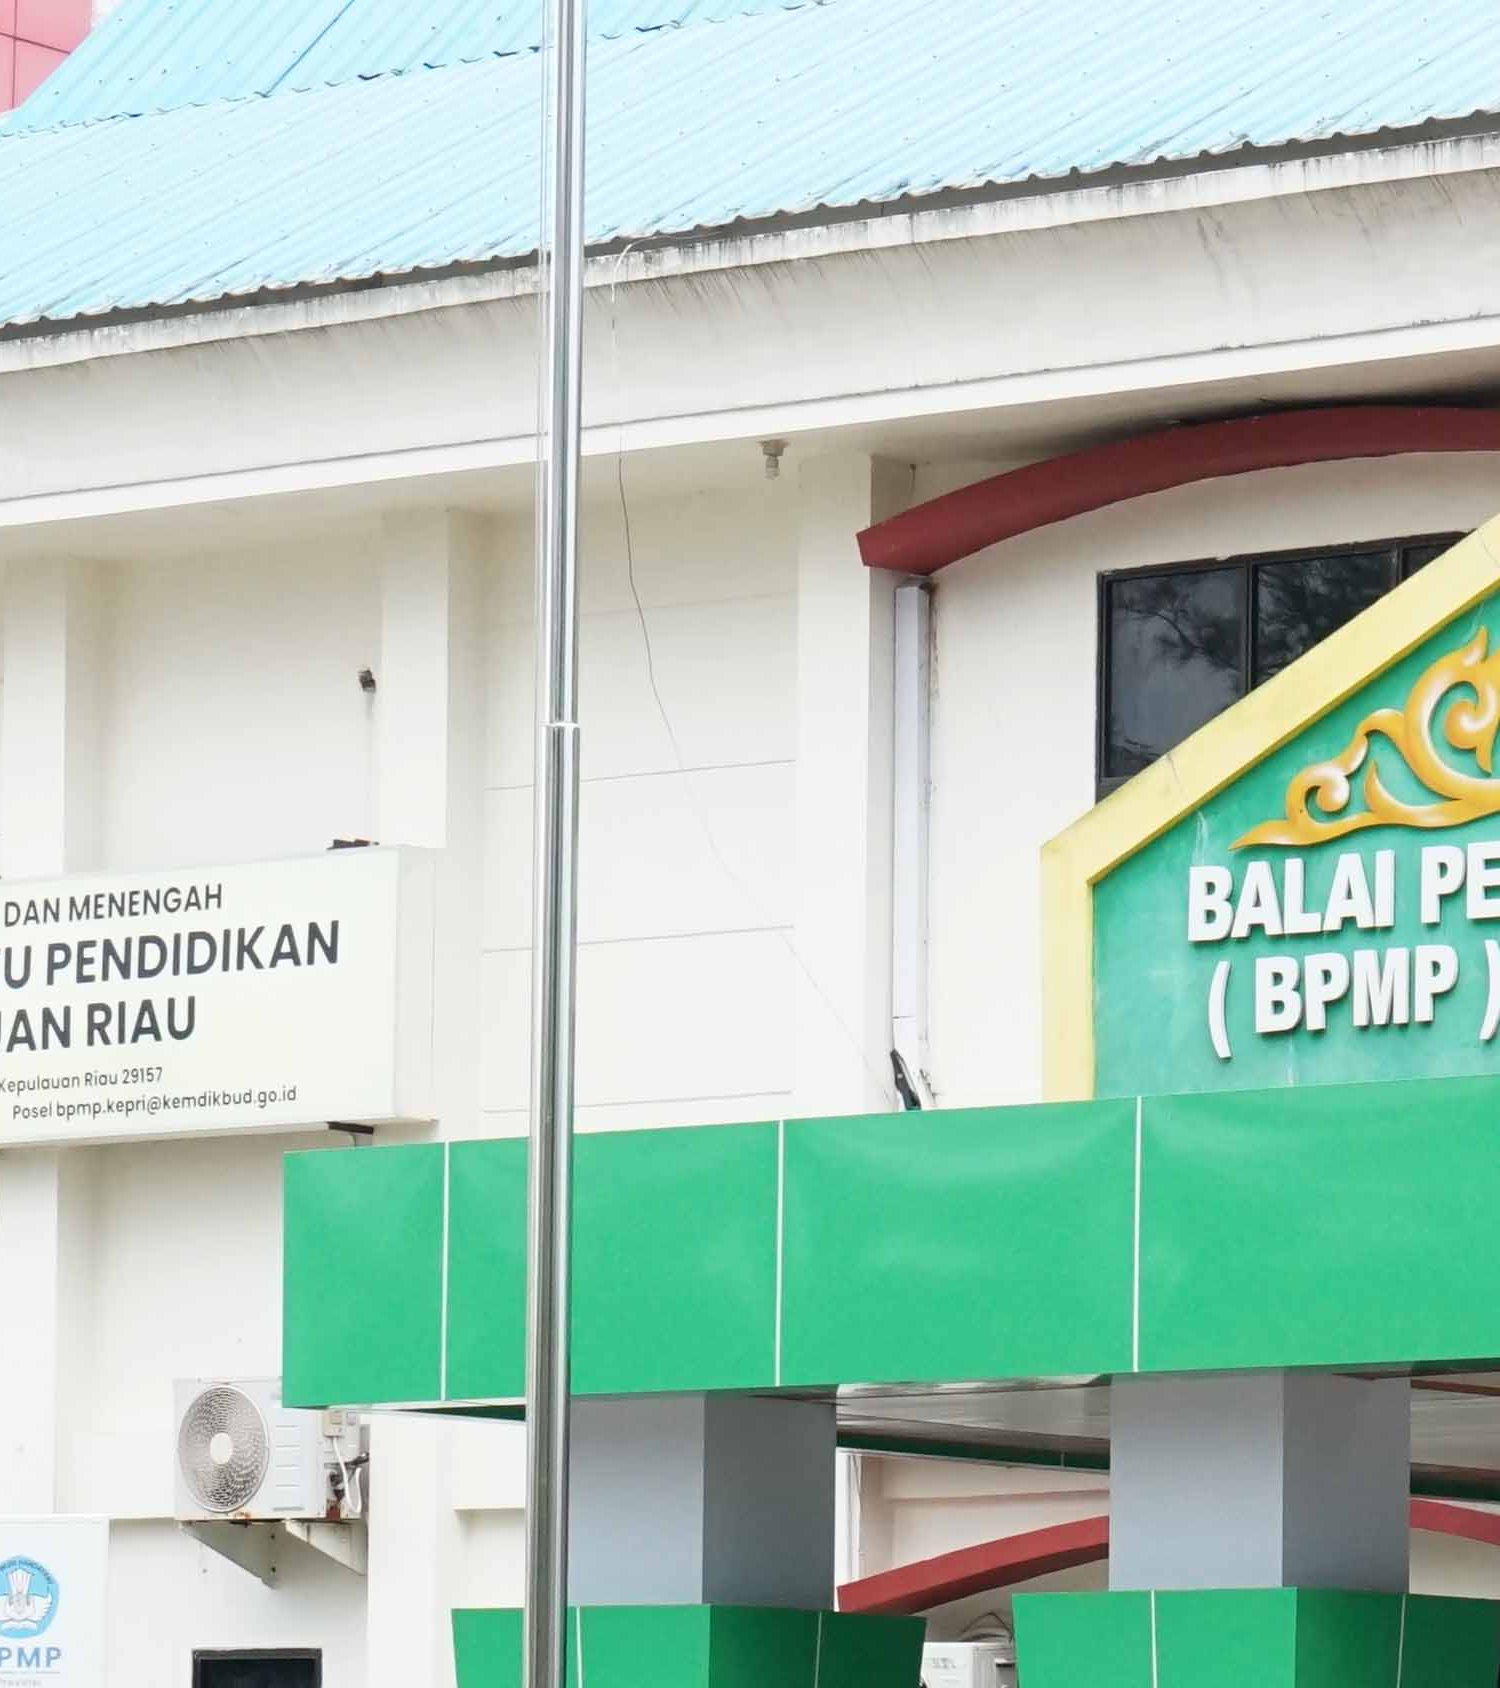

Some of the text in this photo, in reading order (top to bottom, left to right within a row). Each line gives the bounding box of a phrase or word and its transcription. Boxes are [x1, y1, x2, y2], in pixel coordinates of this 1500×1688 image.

[4, 898, 60, 928] DAN
[69, 884, 222, 920] MENENGAH
[1187, 849, 1395, 943] BALAI
[46, 920, 339, 985] PENDIDIKAN
[1254, 944, 1459, 1035] BPMP
[87, 996, 195, 1046] RIAU
[84, 1070, 118, 1088] Riau
[122, 1067, 163, 1084] 29157
[13, 1103, 52, 1121] Posel
[56, 1086, 297, 1123] bpmp.kepri@kemdikbud.go.id
